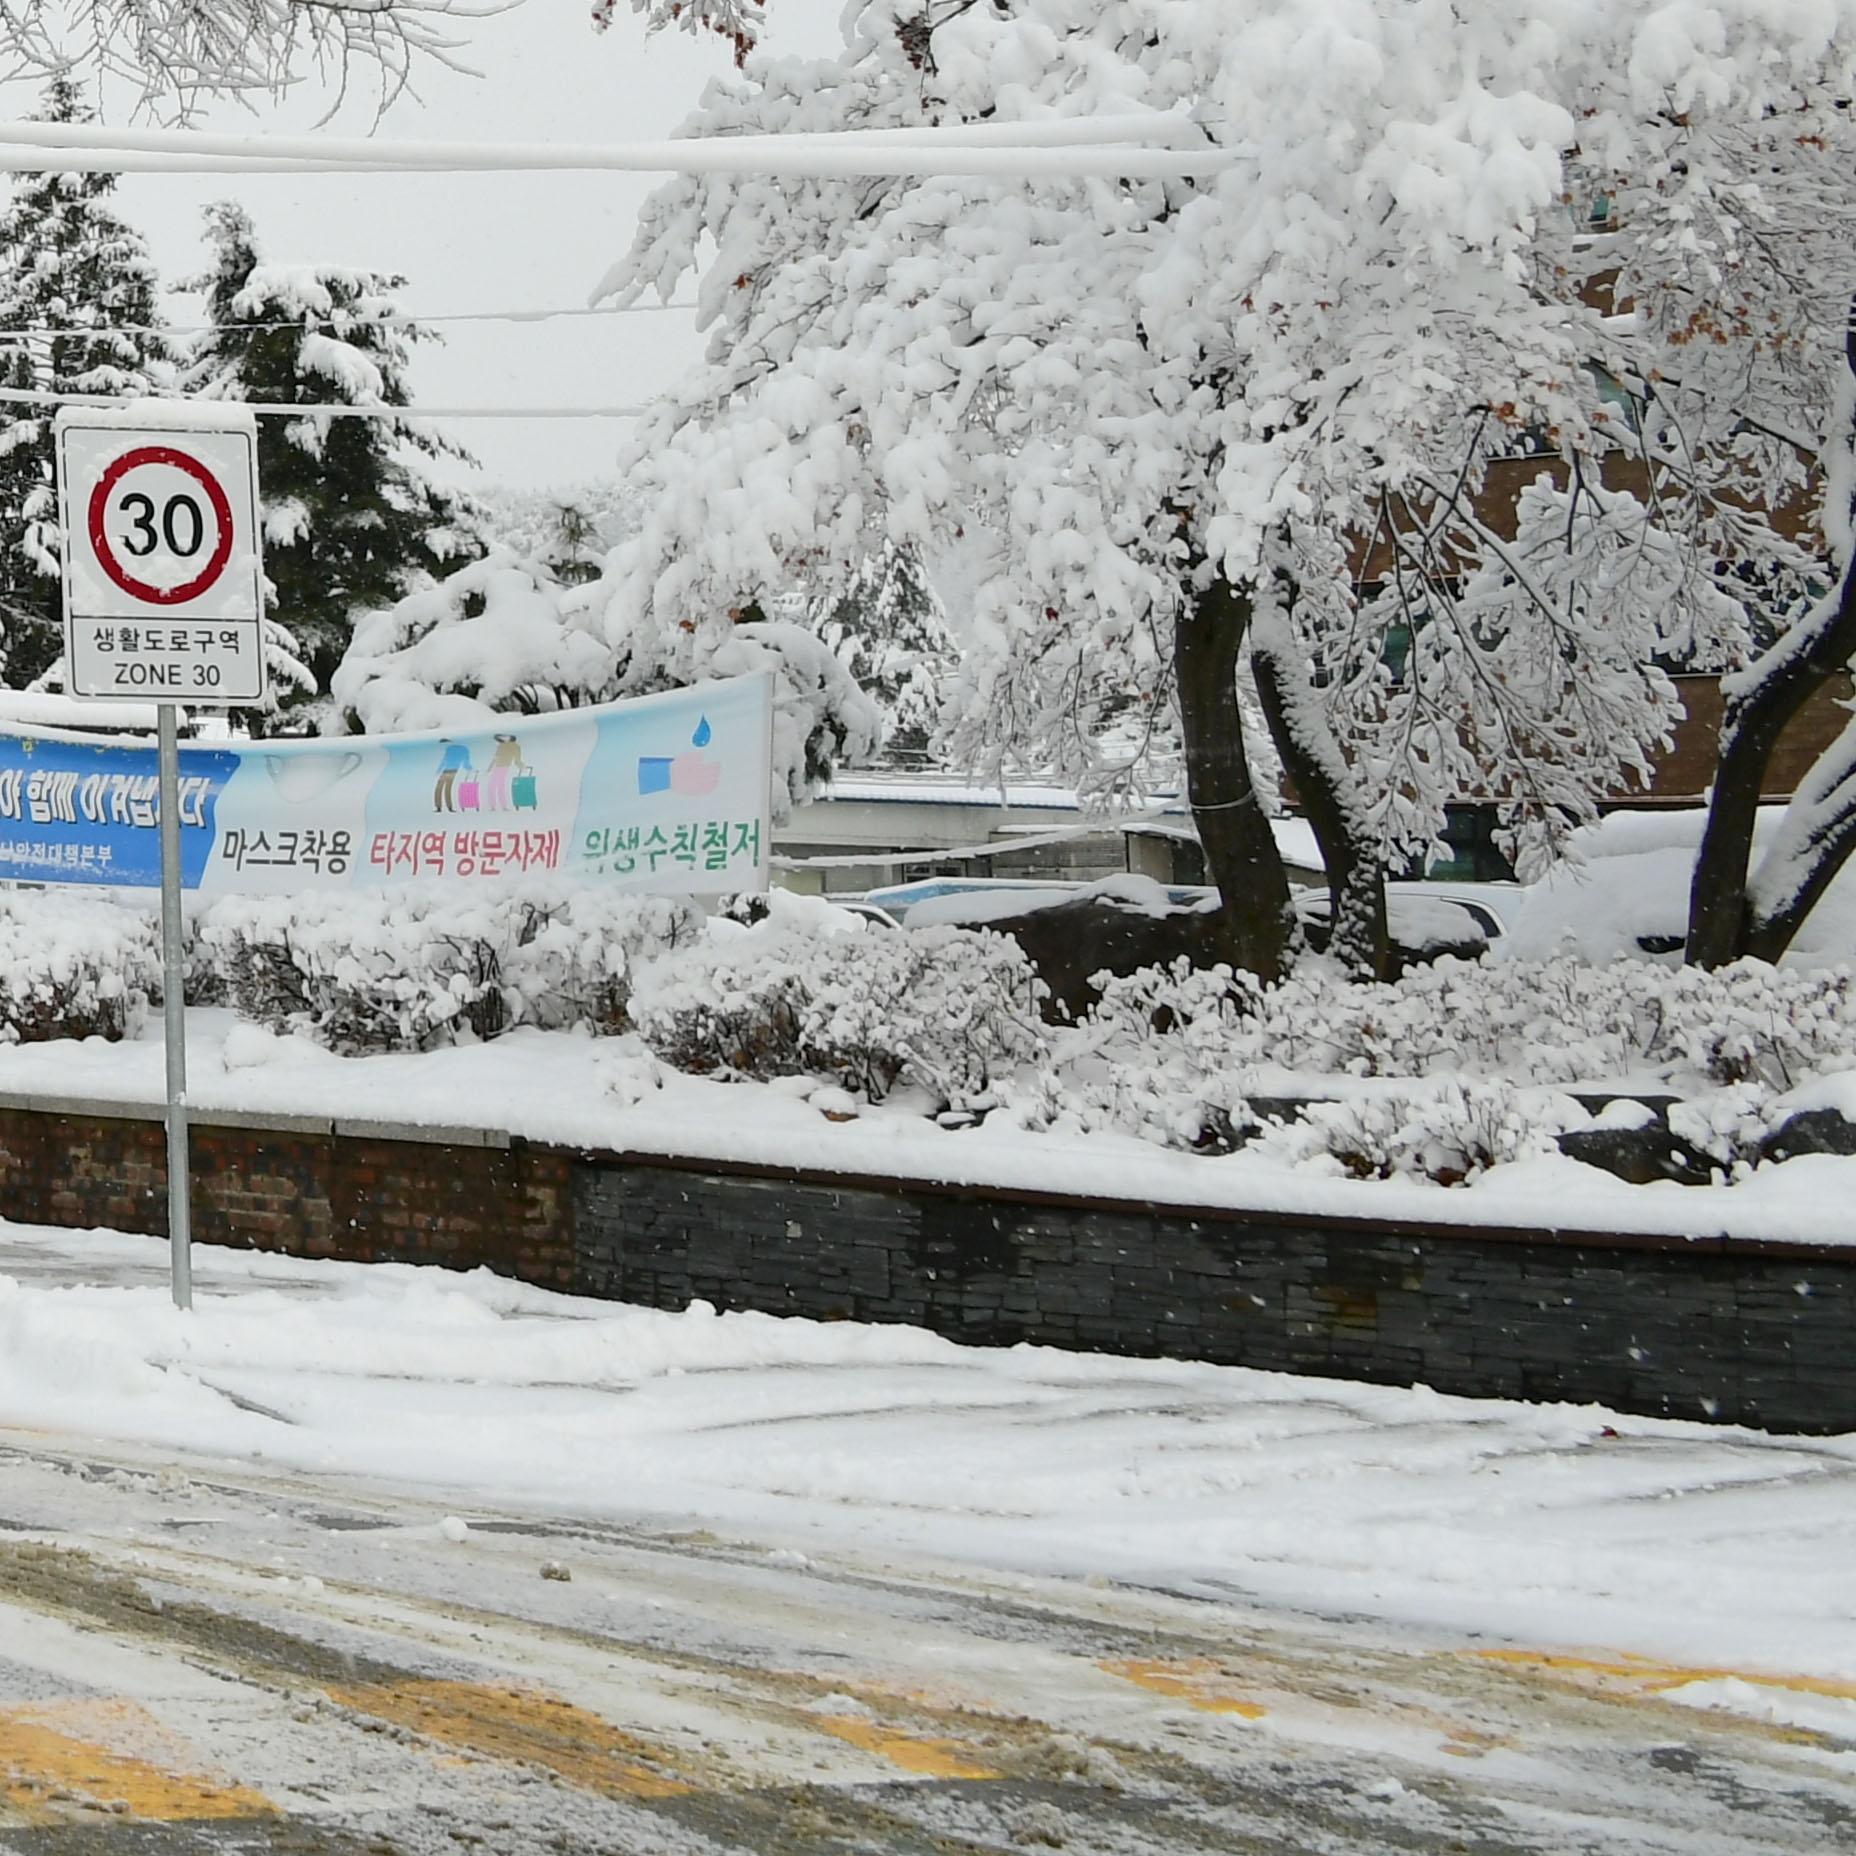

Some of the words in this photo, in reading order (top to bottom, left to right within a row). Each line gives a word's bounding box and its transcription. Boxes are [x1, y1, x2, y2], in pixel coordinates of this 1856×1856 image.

[119, 493, 204, 557] 30
[93, 627, 239, 654] 생활도로구역
[114, 663, 183, 685] ZONE
[192, 664, 221, 686] 30
[27, 769, 81, 825] 함께
[80, 771, 213, 830] 이겨냅다
[222, 828, 351, 875] 마스크착용
[370, 830, 447, 876] 타지역
[453, 829, 561, 877] 방문자제
[583, 818, 760, 874] 위생수칙철저
